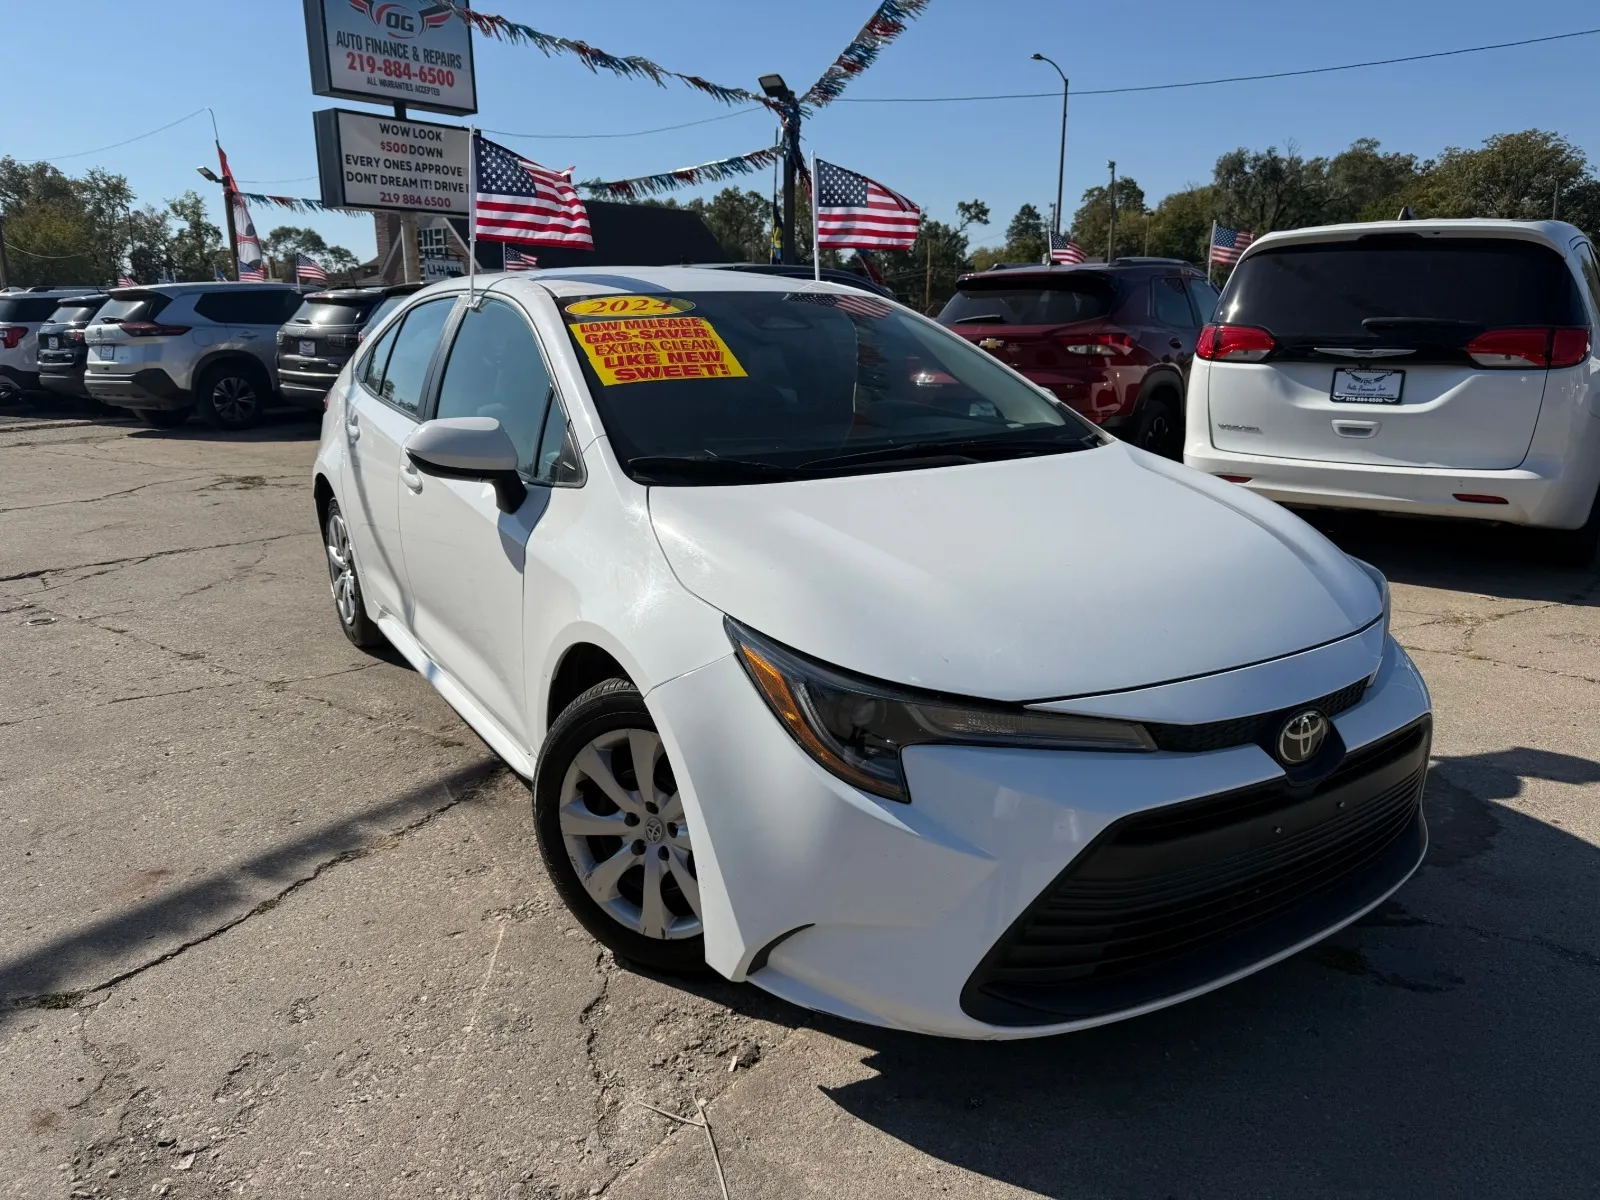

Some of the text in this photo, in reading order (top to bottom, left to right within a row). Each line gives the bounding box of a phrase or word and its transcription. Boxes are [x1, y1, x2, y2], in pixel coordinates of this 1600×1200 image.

[386, 12, 414, 32] OG
[336, 31, 462, 69] AUTO FINANCE & REPAIRS
[346, 51, 455, 88] 219-884-6500
[367, 76, 440, 96] ALL WARRANTIES ACCEPTED
[379, 123, 442, 142] WOW LOOK
[380, 141, 443, 158] $500 DOWN
[345, 154, 463, 177] EVERY ONES APPROVE
[346, 171, 377, 185] DONT
[380, 174, 418, 189] DREAM
[420, 179, 432, 190] IT!
[434, 181, 464, 193] DRIVE
[379, 191, 451, 208] 219 884 6500
[588, 299, 673, 314] 2024
[579, 317, 705, 333] LOW MILEAGE
[584, 329, 711, 344] GAS-SAVER
[595, 339, 720, 356] EXTRA CLEAN
[604, 351, 724, 369] LIKE NEW
[614, 364, 730, 381] SWEET!
